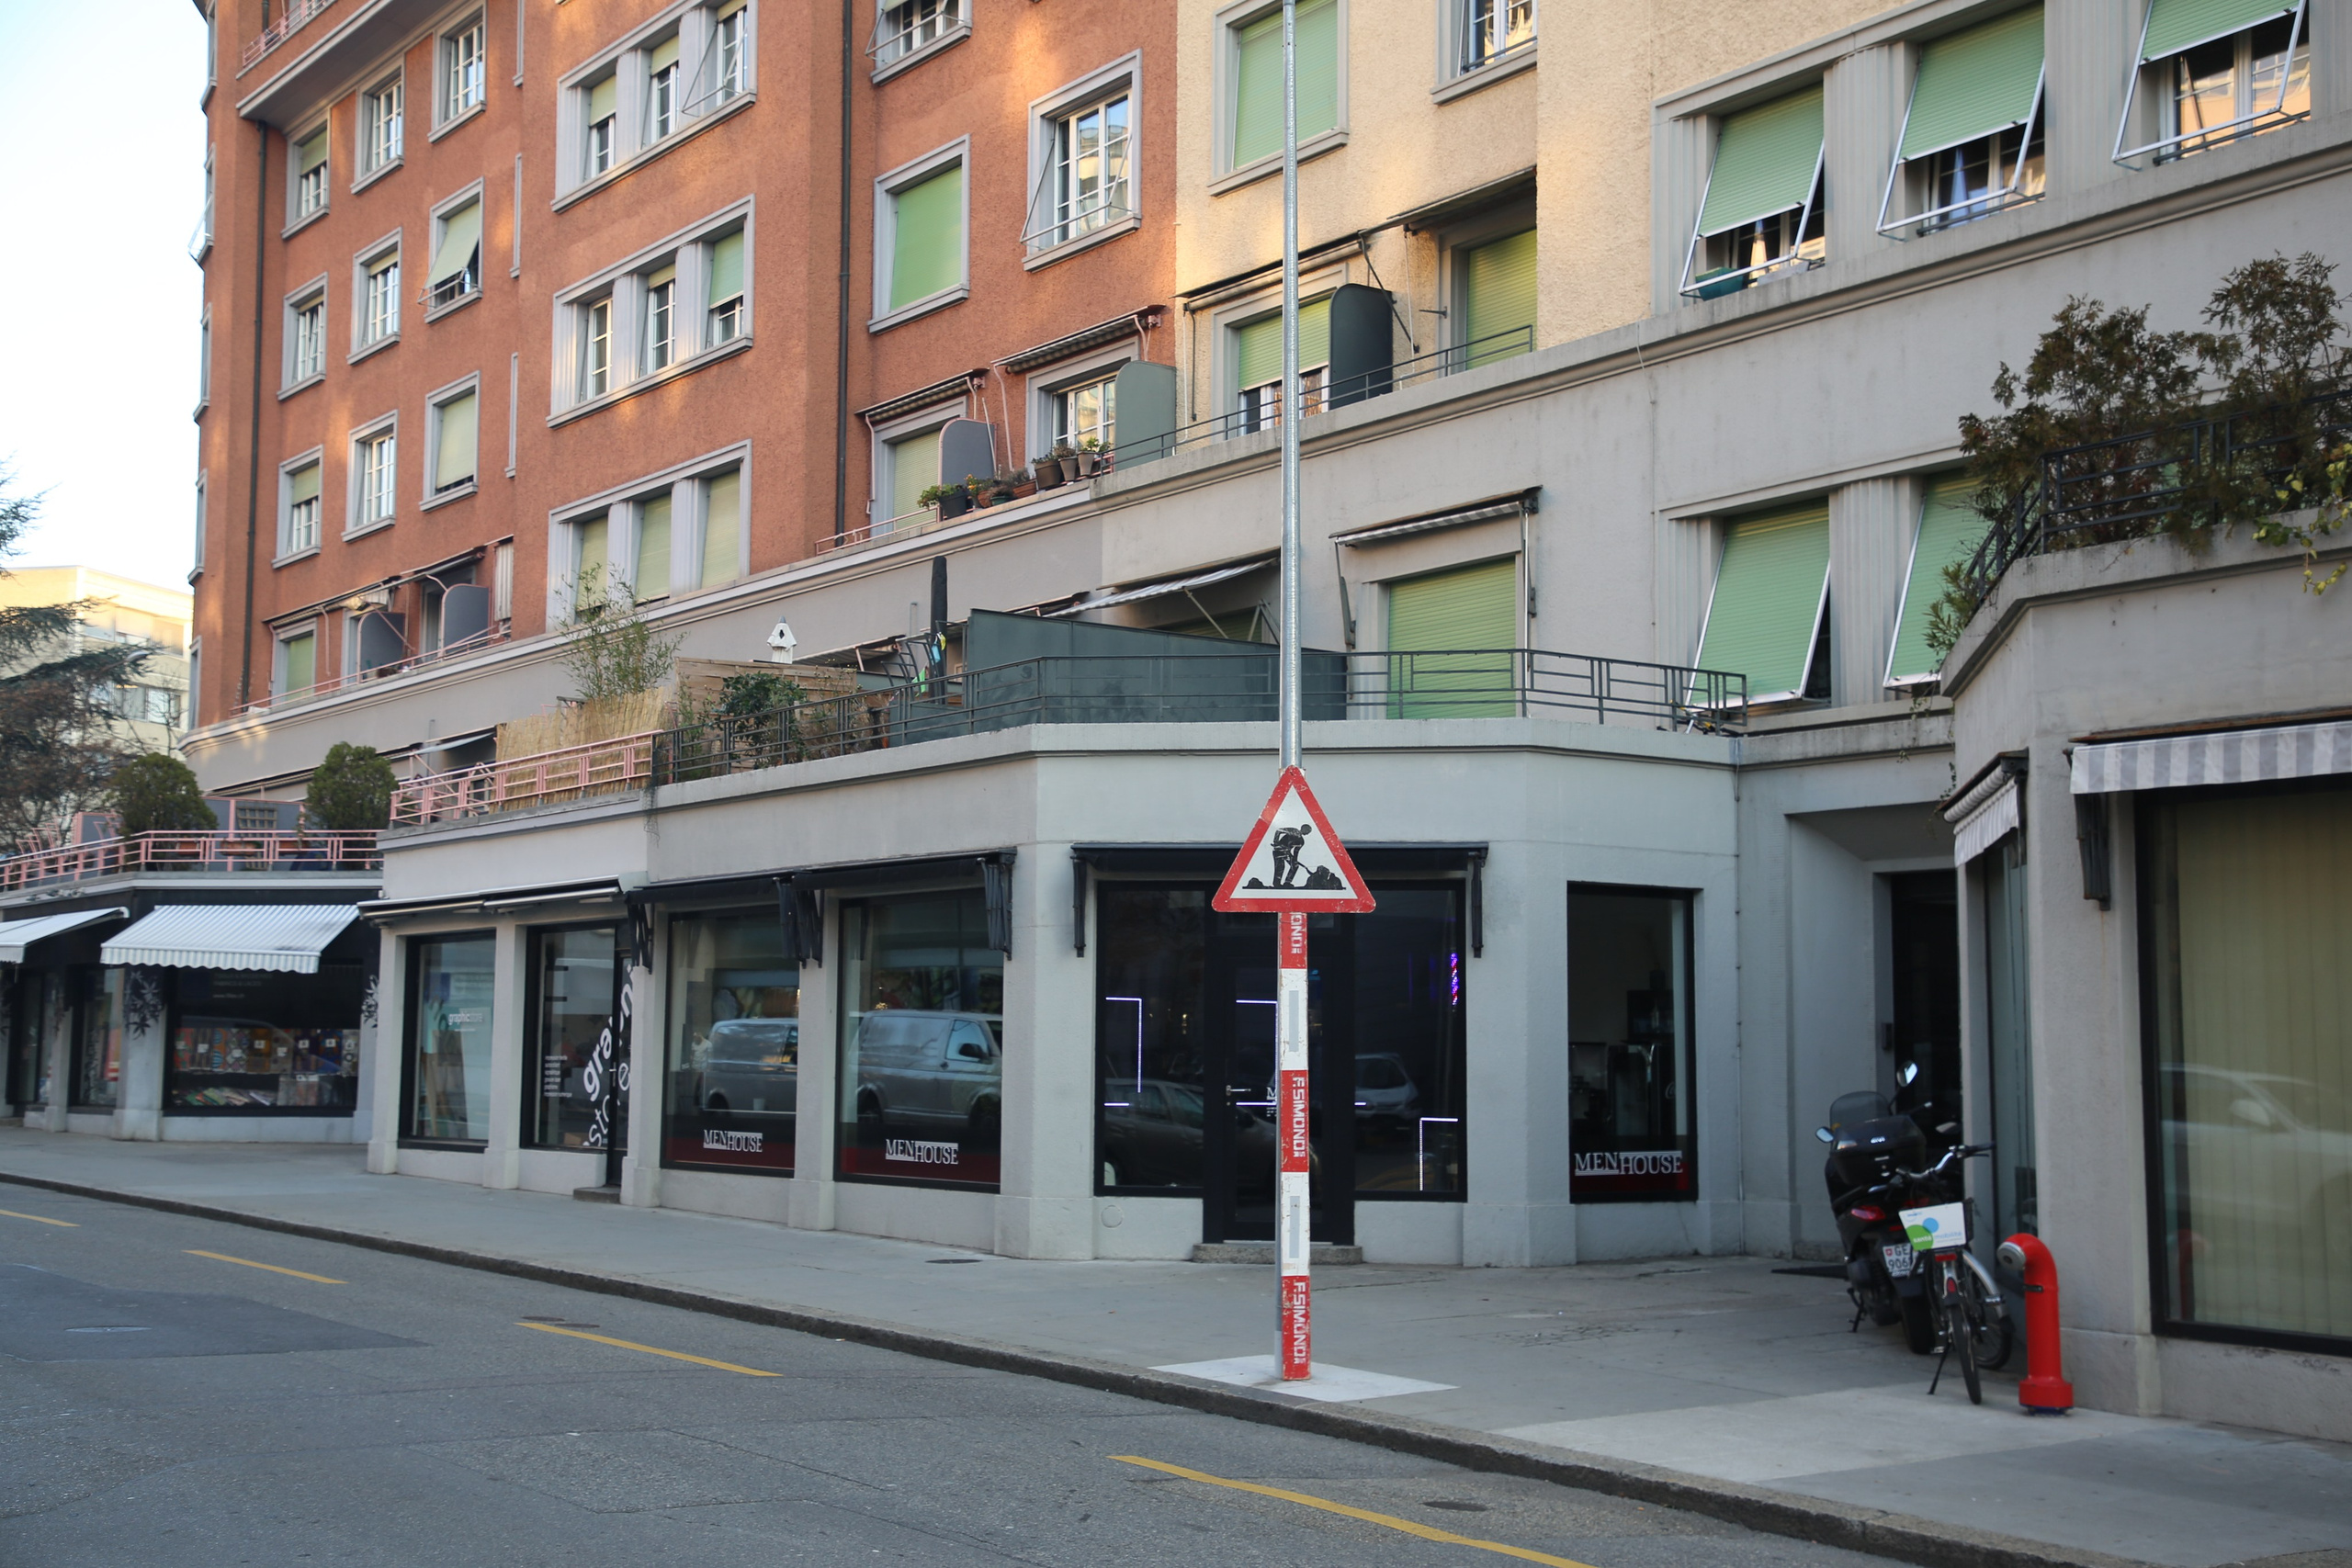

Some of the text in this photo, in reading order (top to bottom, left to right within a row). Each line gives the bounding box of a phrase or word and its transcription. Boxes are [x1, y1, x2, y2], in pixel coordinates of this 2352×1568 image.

[703, 1130, 763, 1153] MENHOUSE
[886, 1139, 959, 1165] MENHOUSE
[1574, 1151, 1683, 1176] MENHOUSE
[1888, 1258, 1912, 1269] 906
